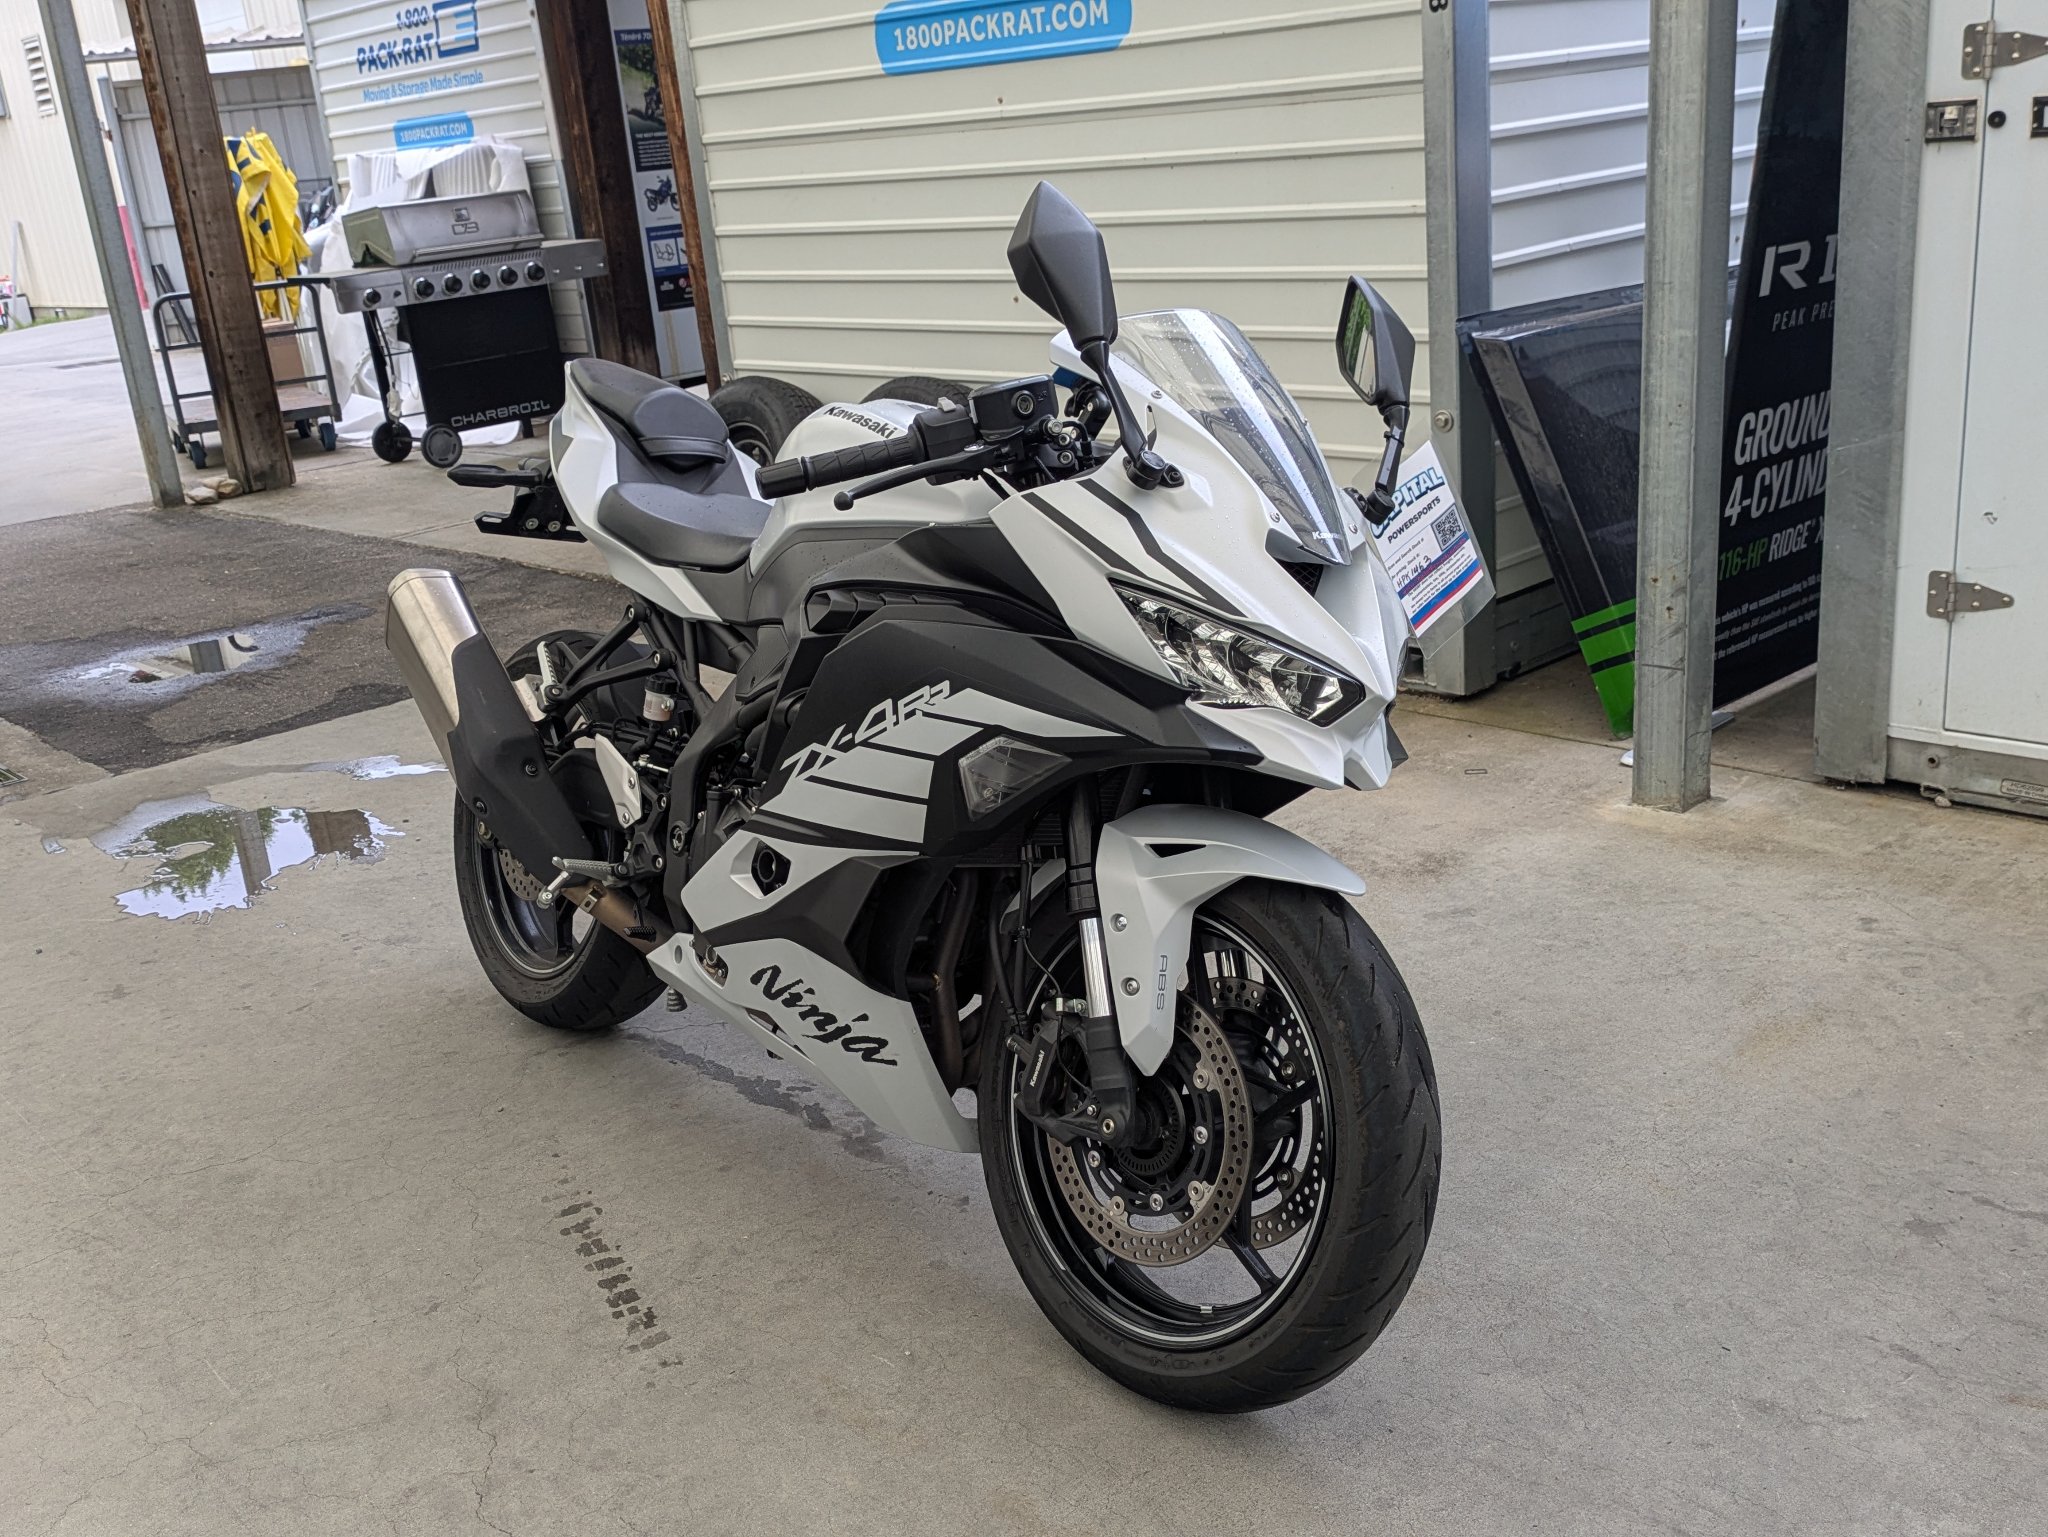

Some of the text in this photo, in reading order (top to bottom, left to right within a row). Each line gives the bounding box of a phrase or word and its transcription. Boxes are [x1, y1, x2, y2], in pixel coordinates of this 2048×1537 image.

[894, 0, 1109, 51] 1800PACKRAT.COM
[356, 32, 434, 74] PACK-RAT
[363, 69, 484, 103] Moving & Storage Made Simple
[400, 121, 468, 143] 1800PACKRAT.COM
[1759, 233, 1838, 298] RI
[1771, 306, 1807, 333] PEAK
[450, 399, 551, 428] CHARBROIL
[823, 404, 898, 440] Kawasaki
[1387, 495, 1441, 545] POWERSPORTS
[1718, 537, 1769, 580] 116-HP
[1156, 954, 1168, 1011] ABS
[749, 963, 898, 1068] Ninja
[1029, 1050, 1045, 1087] Kawasaki
